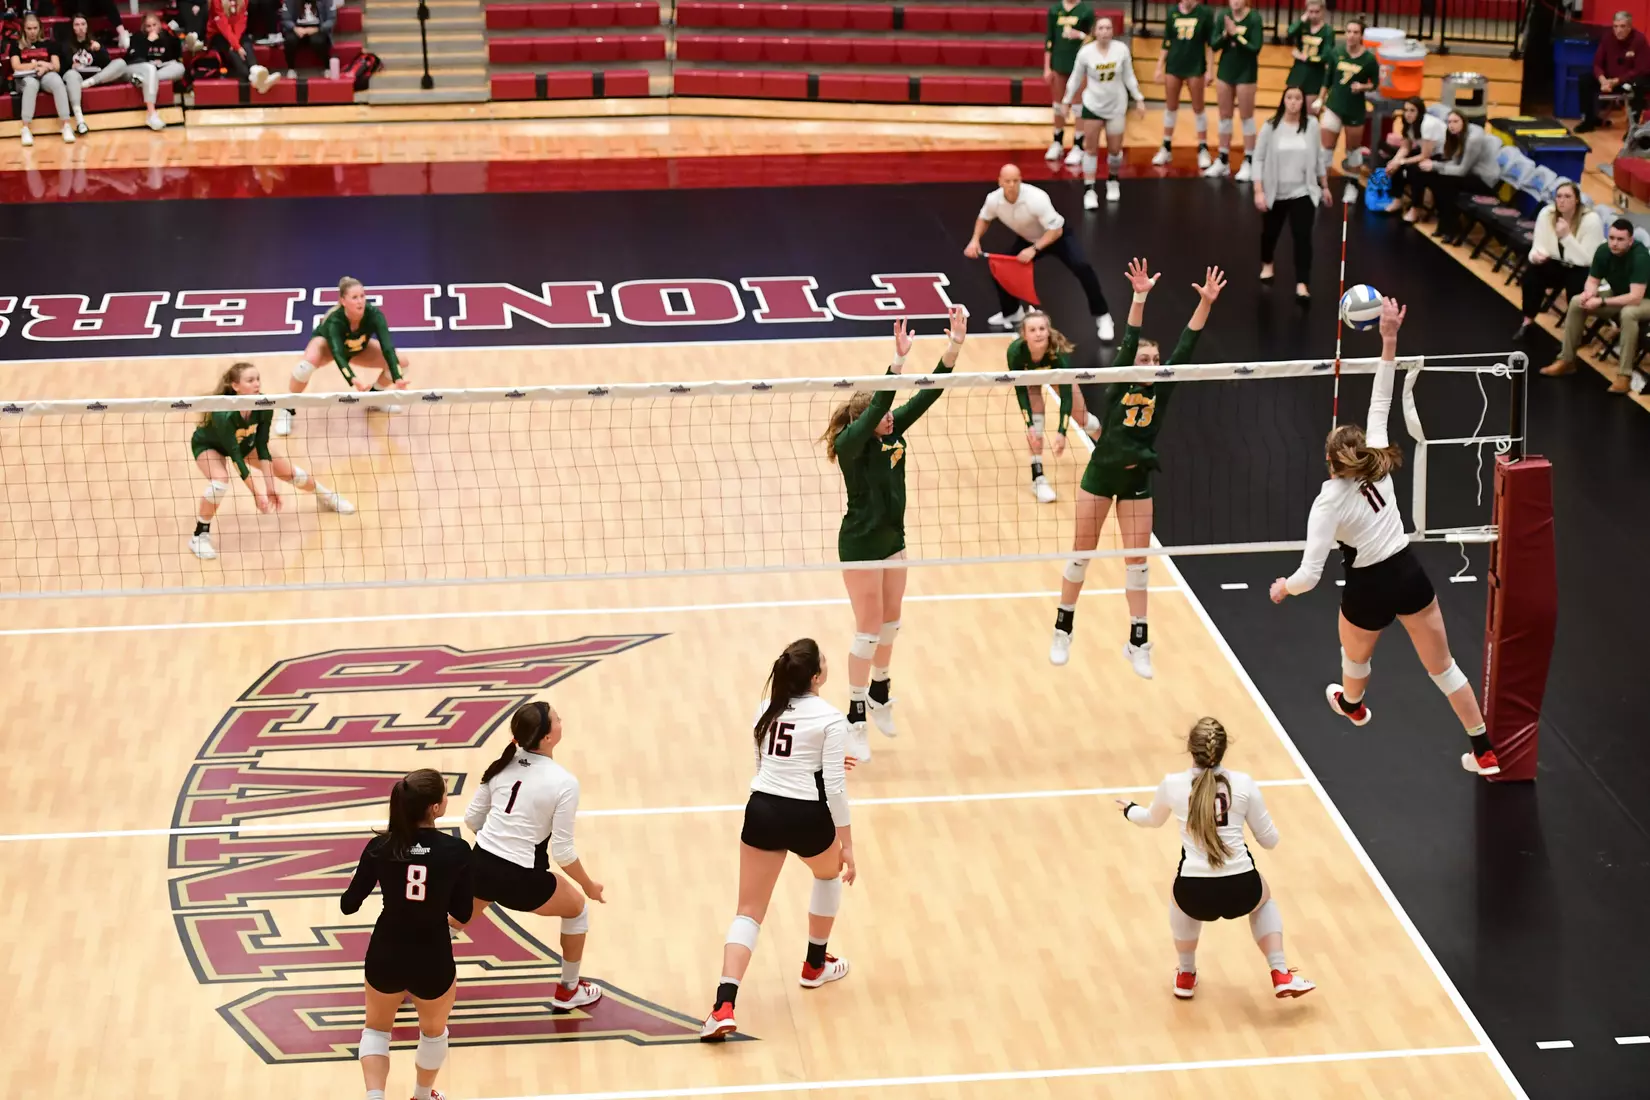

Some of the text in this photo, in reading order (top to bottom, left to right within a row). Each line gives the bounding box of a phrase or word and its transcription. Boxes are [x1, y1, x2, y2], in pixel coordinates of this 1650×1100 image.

[0, 271, 970, 343] PIONEER
[767, 720, 796, 758] 15
[504, 780, 523, 814] 1
[405, 864, 428, 902] 8
